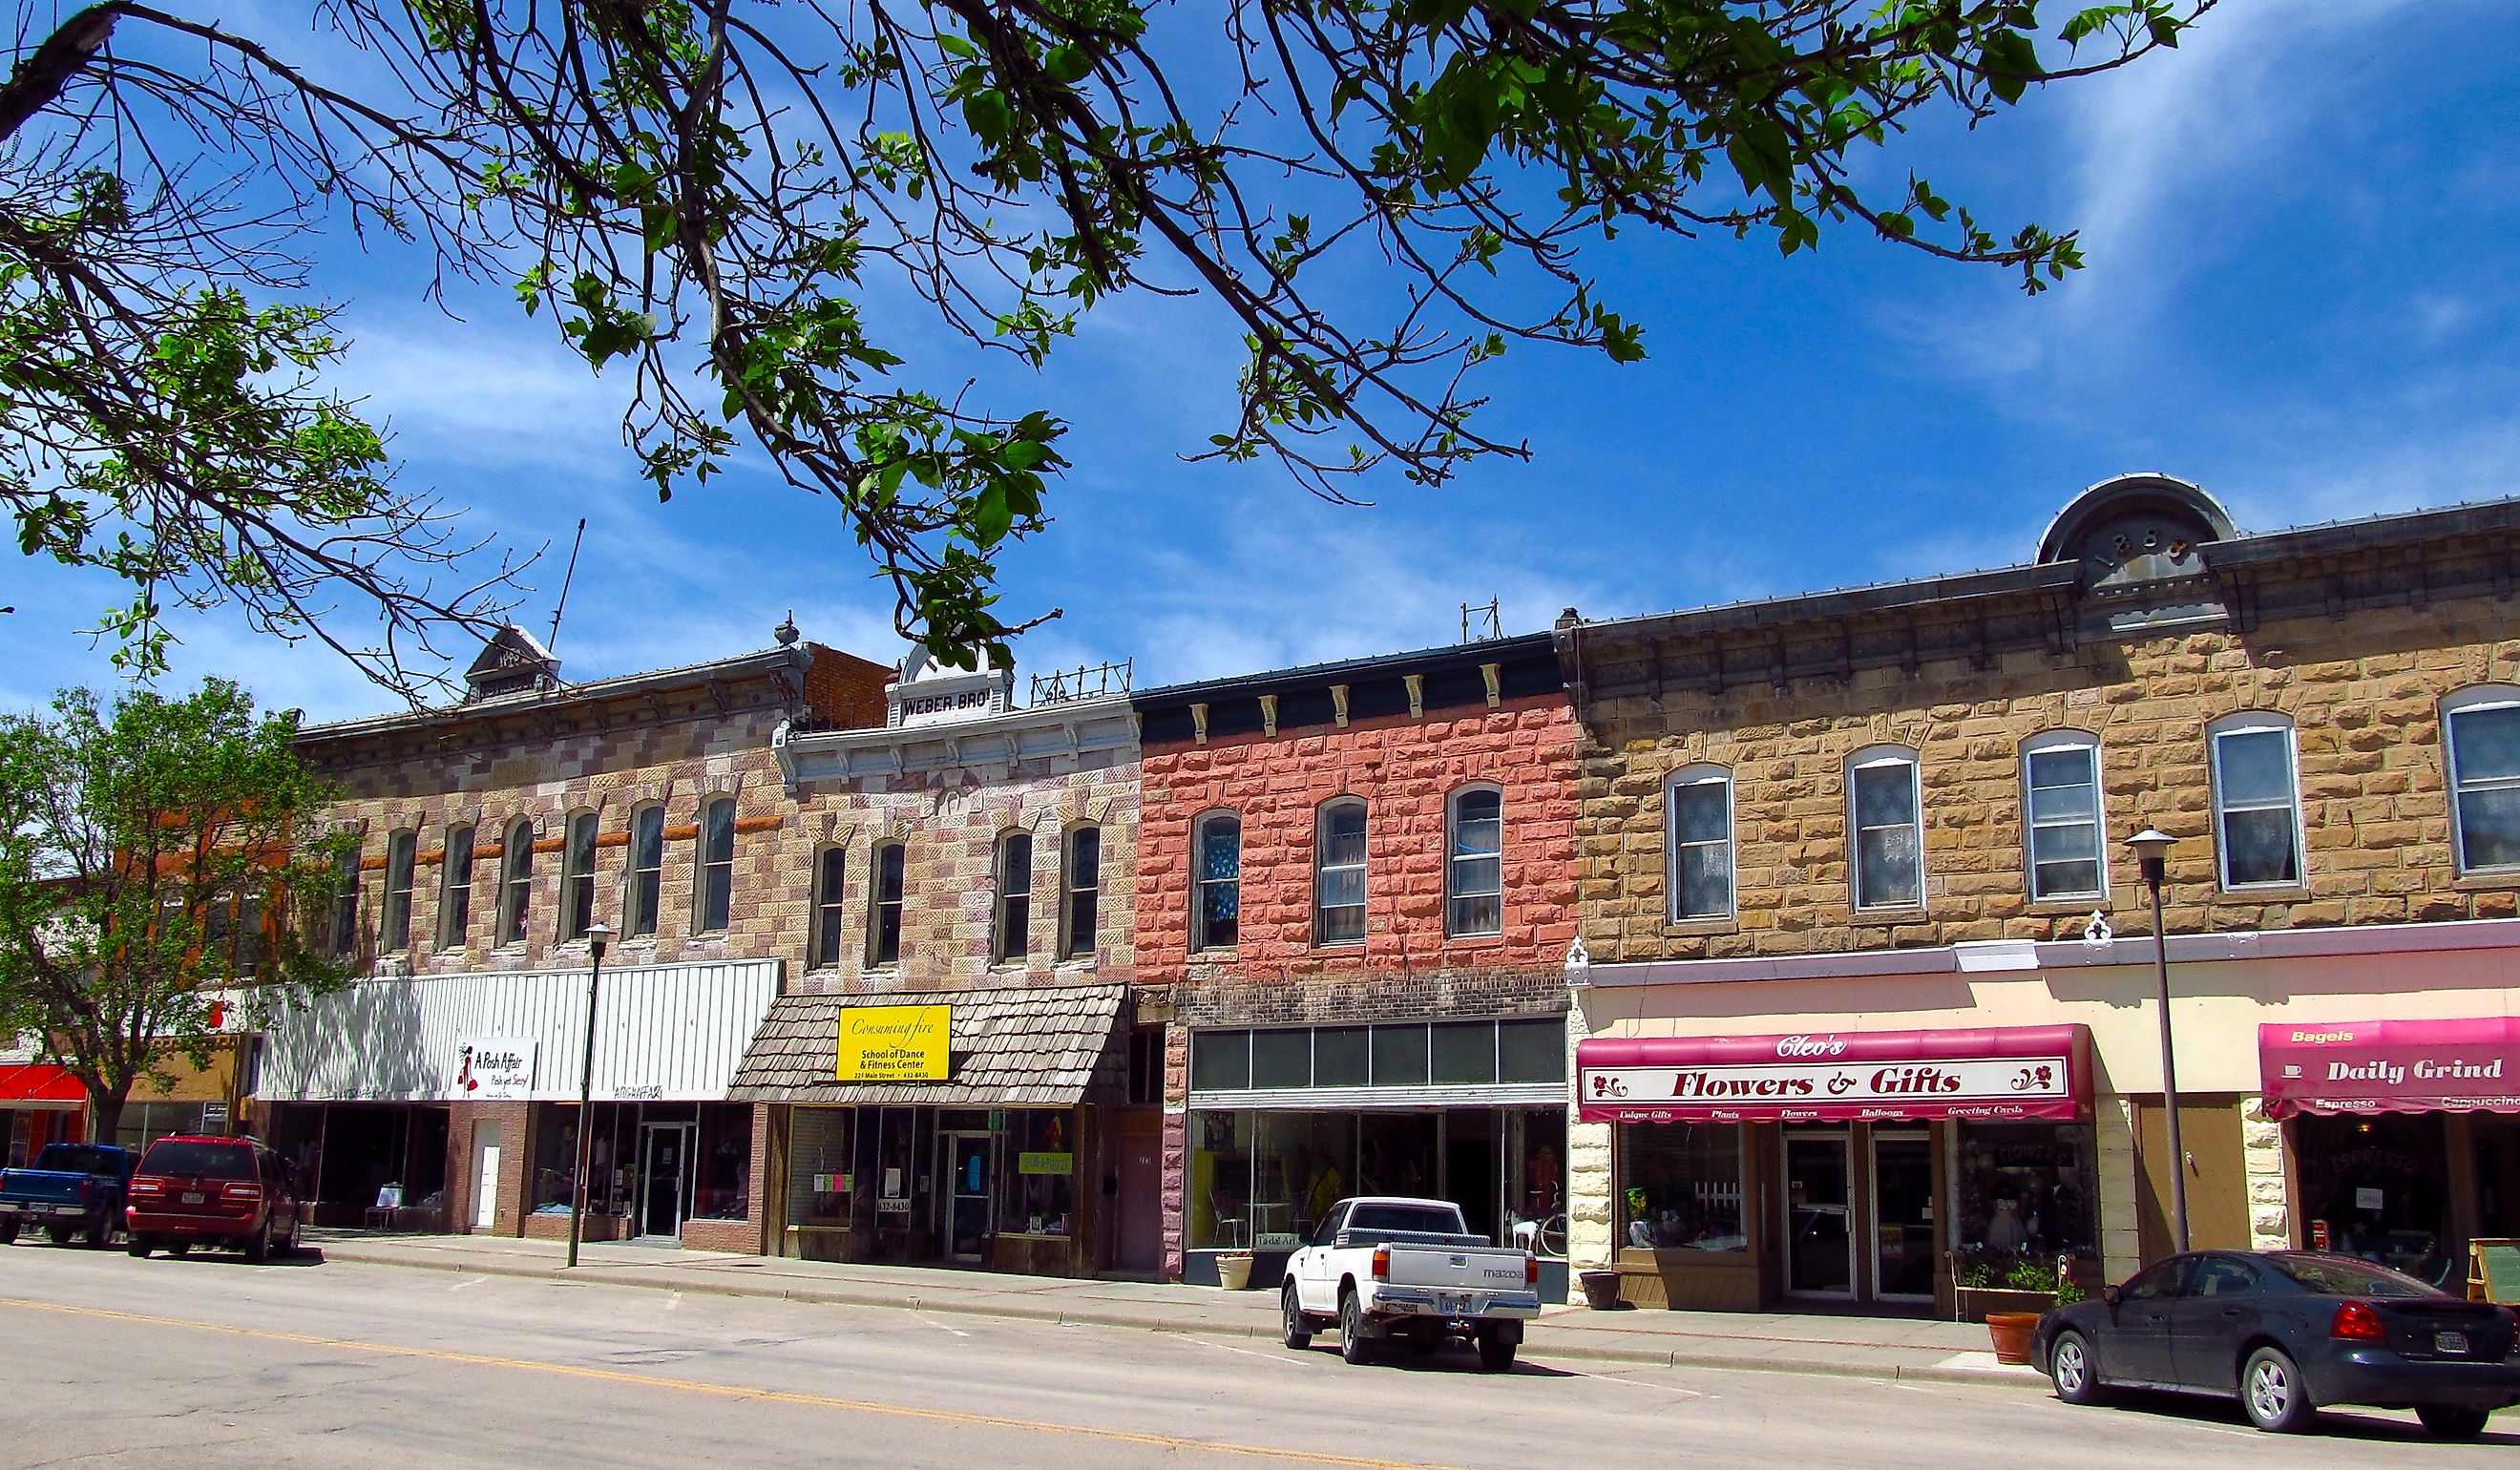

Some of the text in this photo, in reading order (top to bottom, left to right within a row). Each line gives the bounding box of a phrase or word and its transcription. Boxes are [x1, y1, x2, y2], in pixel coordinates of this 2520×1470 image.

[851, 1006, 934, 1048] Consuming fire
[2291, 1031, 2354, 1044] Bagels
[1775, 1034, 1847, 1058] Cleo's
[861, 1049, 925, 1060] School of Dance
[474, 1051, 523, 1073] A Posh Affair
[860, 1060, 924, 1070] & Fitness Center
[2326, 1059, 2503, 1085] Daily Grind
[1670, 1066, 1961, 1097] Flowers & Gifts
[2315, 1099, 2376, 1109] Espresso
[2441, 1095, 2520, 1108] Cappuccino
[1619, 1110, 1672, 1120] Unique Gifts
[1711, 1110, 1740, 1119] Plants
[1780, 1109, 1818, 1118] Flowers
[1861, 1108, 1904, 1117] Balloons
[1947, 1104, 2024, 1116] Greeting Cards
[1998, 1144, 2067, 1166] FLOWERS
[2329, 1148, 2419, 1174] ESPRESSO
